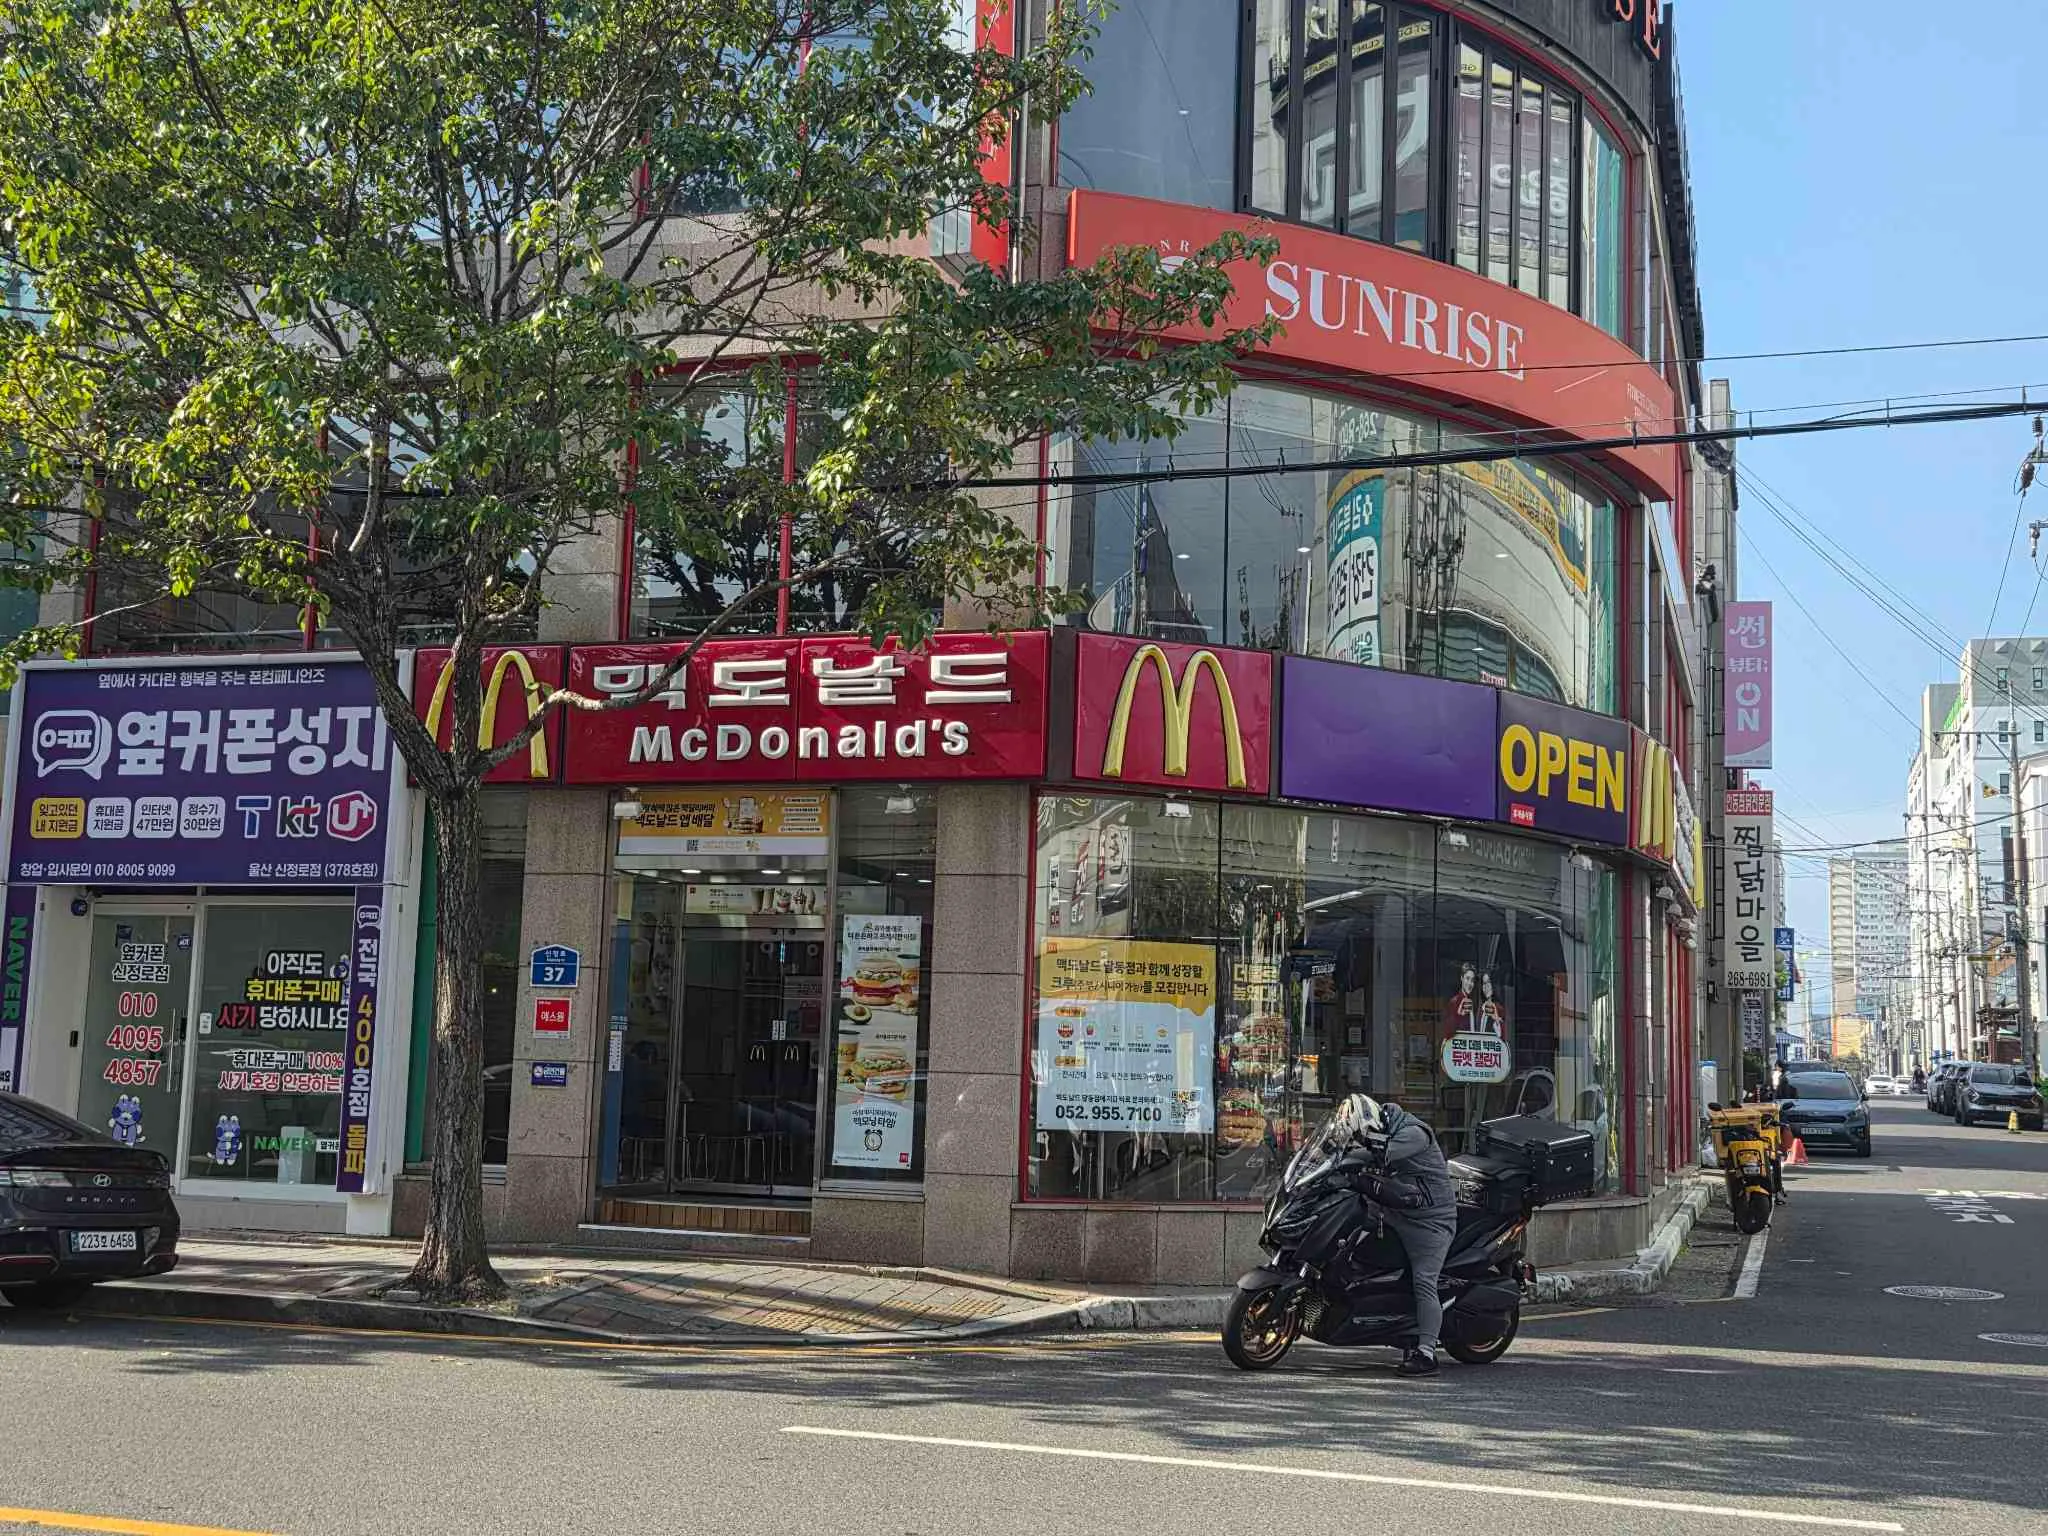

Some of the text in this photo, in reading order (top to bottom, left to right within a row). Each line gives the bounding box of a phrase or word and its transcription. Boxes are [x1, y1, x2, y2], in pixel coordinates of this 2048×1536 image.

[1265, 260, 1527, 382] SUNRISE
[1729, 615, 1767, 648] 썬
[98, 673, 136, 689] 옆에서
[139, 672, 177, 688] 커다란
[180, 671, 218, 687] 행복을
[220, 671, 246, 686] 주는
[593, 651, 1012, 710] 맥도날드
[117, 705, 387, 776] 옆커폰성지
[628, 719, 969, 763] McDonald's
[1500, 724, 1625, 813] OPEN
[39, 802, 79, 817] 잊고있던
[95, 804, 125, 817] 휴대폰
[141, 803, 173, 817] 인터넷
[188, 803, 219, 817] 정수기
[276, 795, 321, 838] kt
[36, 819, 79, 833] 내 지원금
[93, 819, 124, 832] 지원금
[136, 818, 175, 833] 47만원
[183, 817, 222, 832] 30만원
[94, 863, 113, 876] 010
[116, 863, 145, 876] 8005
[147, 863, 176, 876] 9099
[248, 862, 378, 878] 울산 신정로점 (378호점)
[1733, 825, 1767, 962] 찜닭마을
[2, 916, 29, 1021] NAVER
[112, 964, 170, 983] 신정로점
[266, 952, 323, 976] 아직도
[543, 966, 565, 982] 37
[1056, 958, 1102, 972] 맥도날드
[1148, 961, 1170, 976] 함께
[1171, 963, 1204, 979] 성장할
[246, 979, 341, 1003] 휴대폰구매
[1154, 982, 1209, 997] 모집합니다
[119, 991, 158, 1017] 010
[218, 1004, 257, 1029] 사기
[106, 1025, 163, 1051] 4095
[233, 1050, 344, 1070] 휴대폰구매 100%
[104, 1059, 161, 1086] 4857
